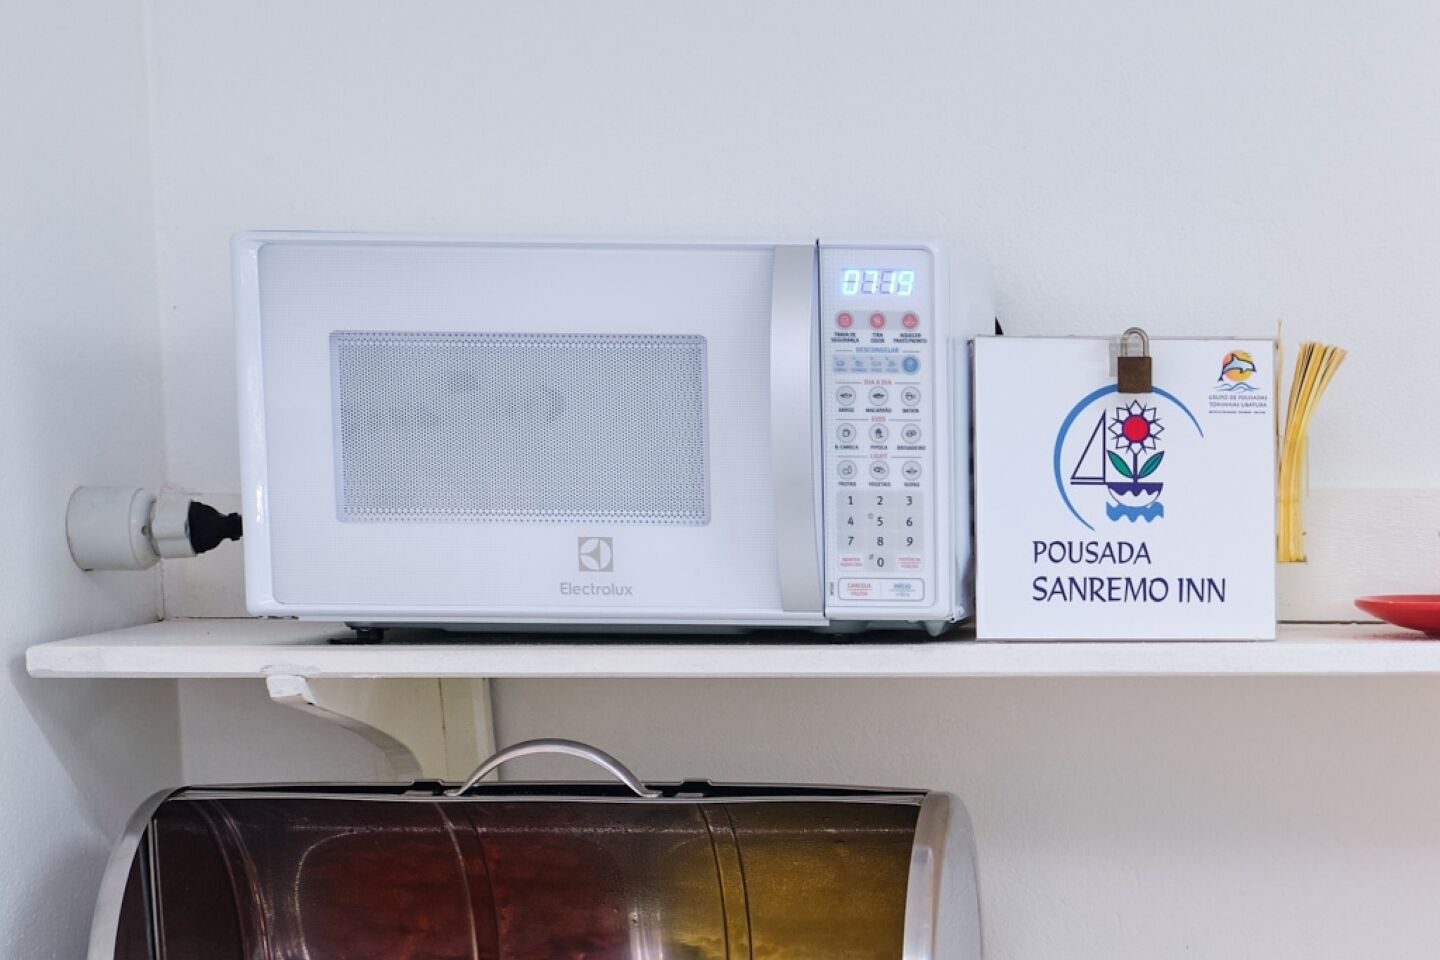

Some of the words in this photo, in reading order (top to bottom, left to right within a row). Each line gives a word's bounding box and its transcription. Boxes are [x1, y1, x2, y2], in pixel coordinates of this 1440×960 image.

[842, 269, 914, 296] 0719
[848, 496, 853, 505] 1
[876, 496, 883, 505] 2
[906, 496, 913, 506] 3
[847, 516, 854, 526] 4
[877, 516, 884, 526] 5
[906, 517, 913, 527] 6
[848, 536, 854, 546] 7
[877, 536, 884, 546] 8
[906, 536, 914, 547] 9
[1032, 540, 1151, 564] POUSADA
[877, 557, 885, 567] 0
[560, 582, 633, 596] Electrolux
[1032, 575, 1169, 603] SANREMO
[1177, 577, 1226, 603] INN
